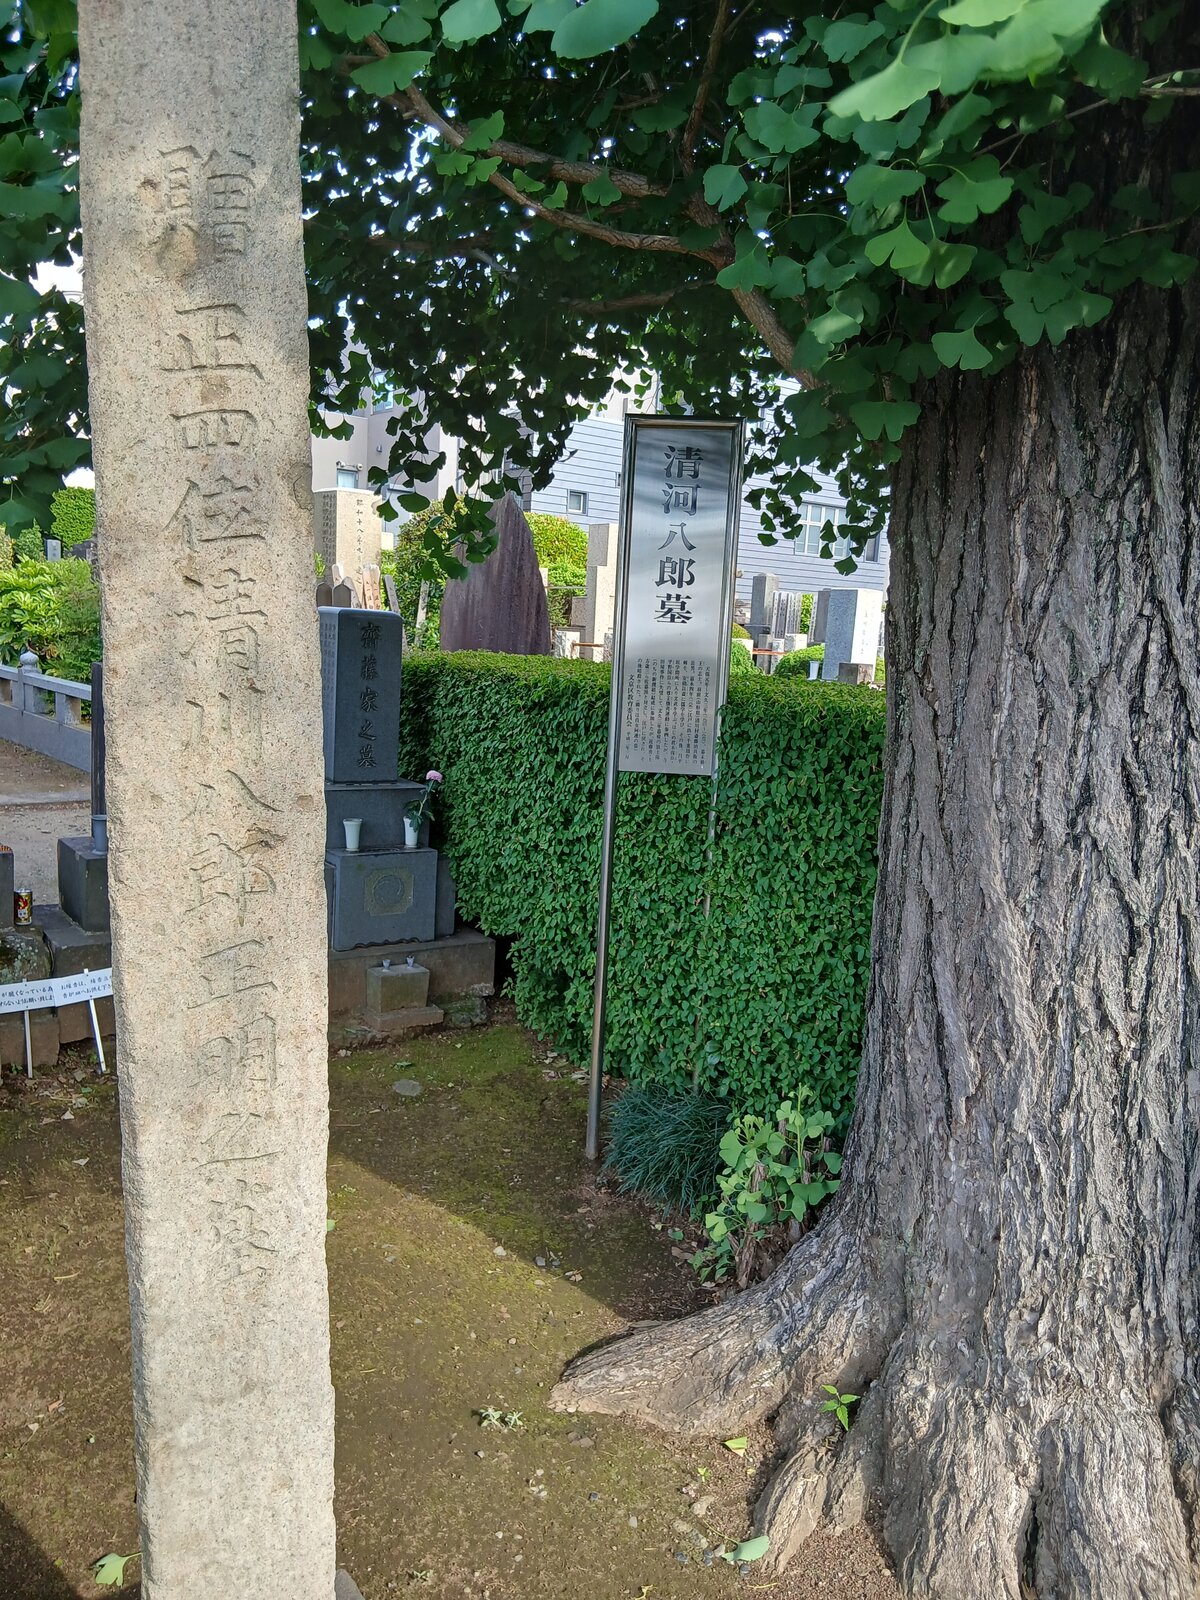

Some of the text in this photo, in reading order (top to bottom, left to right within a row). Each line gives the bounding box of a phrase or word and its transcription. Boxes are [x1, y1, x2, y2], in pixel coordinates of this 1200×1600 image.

[654, 445, 704, 624] 清河八郎墓
